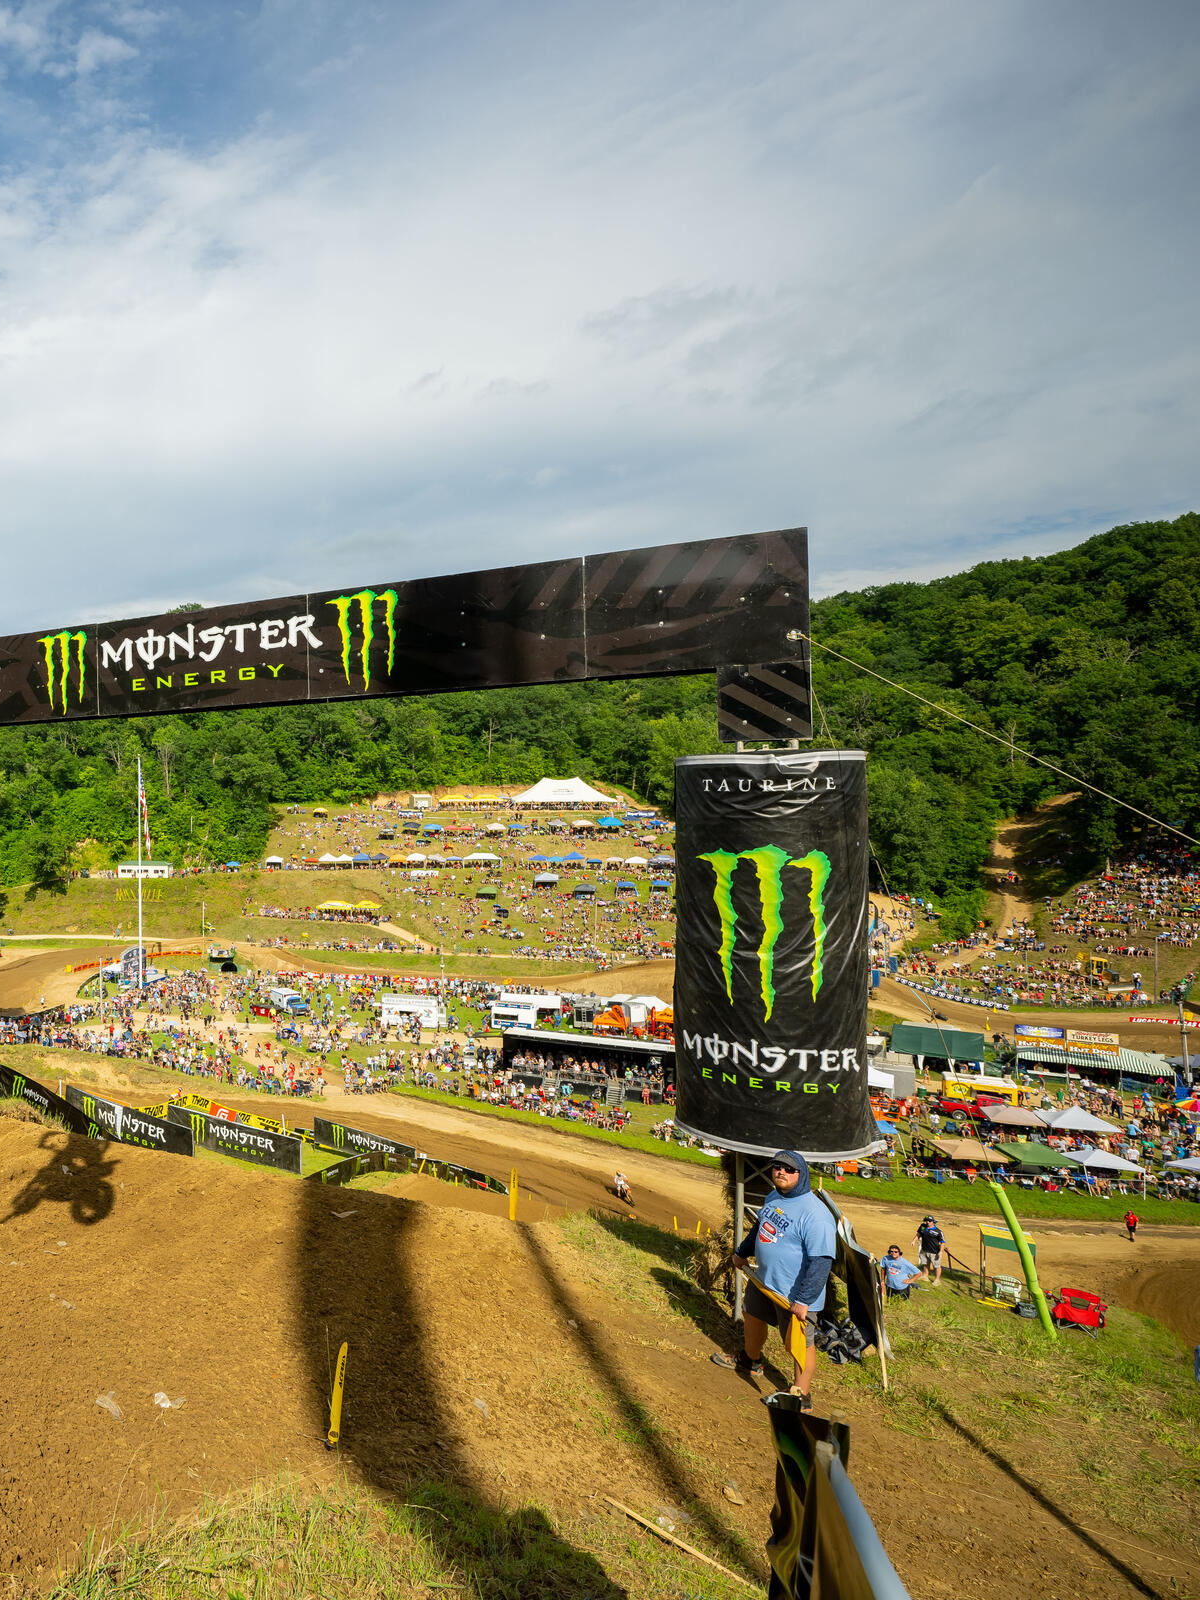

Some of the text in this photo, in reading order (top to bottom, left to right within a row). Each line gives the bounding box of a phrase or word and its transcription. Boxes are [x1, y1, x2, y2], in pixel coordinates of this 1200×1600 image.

[101, 614, 323, 672] MONSTER
[131, 663, 285, 692] ENERGY
[702, 776, 836, 793] TAURINE
[683, 1029, 860, 1072] MONSTER
[702, 1067, 840, 1094] ENERGY
[191, 1094, 210, 1109] THOR
[98, 1107, 167, 1143] MONSTER
[209, 1123, 275, 1152] MONSTER
[218, 1140, 265, 1157] ENERGY
[347, 1131, 396, 1154] MONSTER
[761, 1207, 790, 1231] FLAGGER
